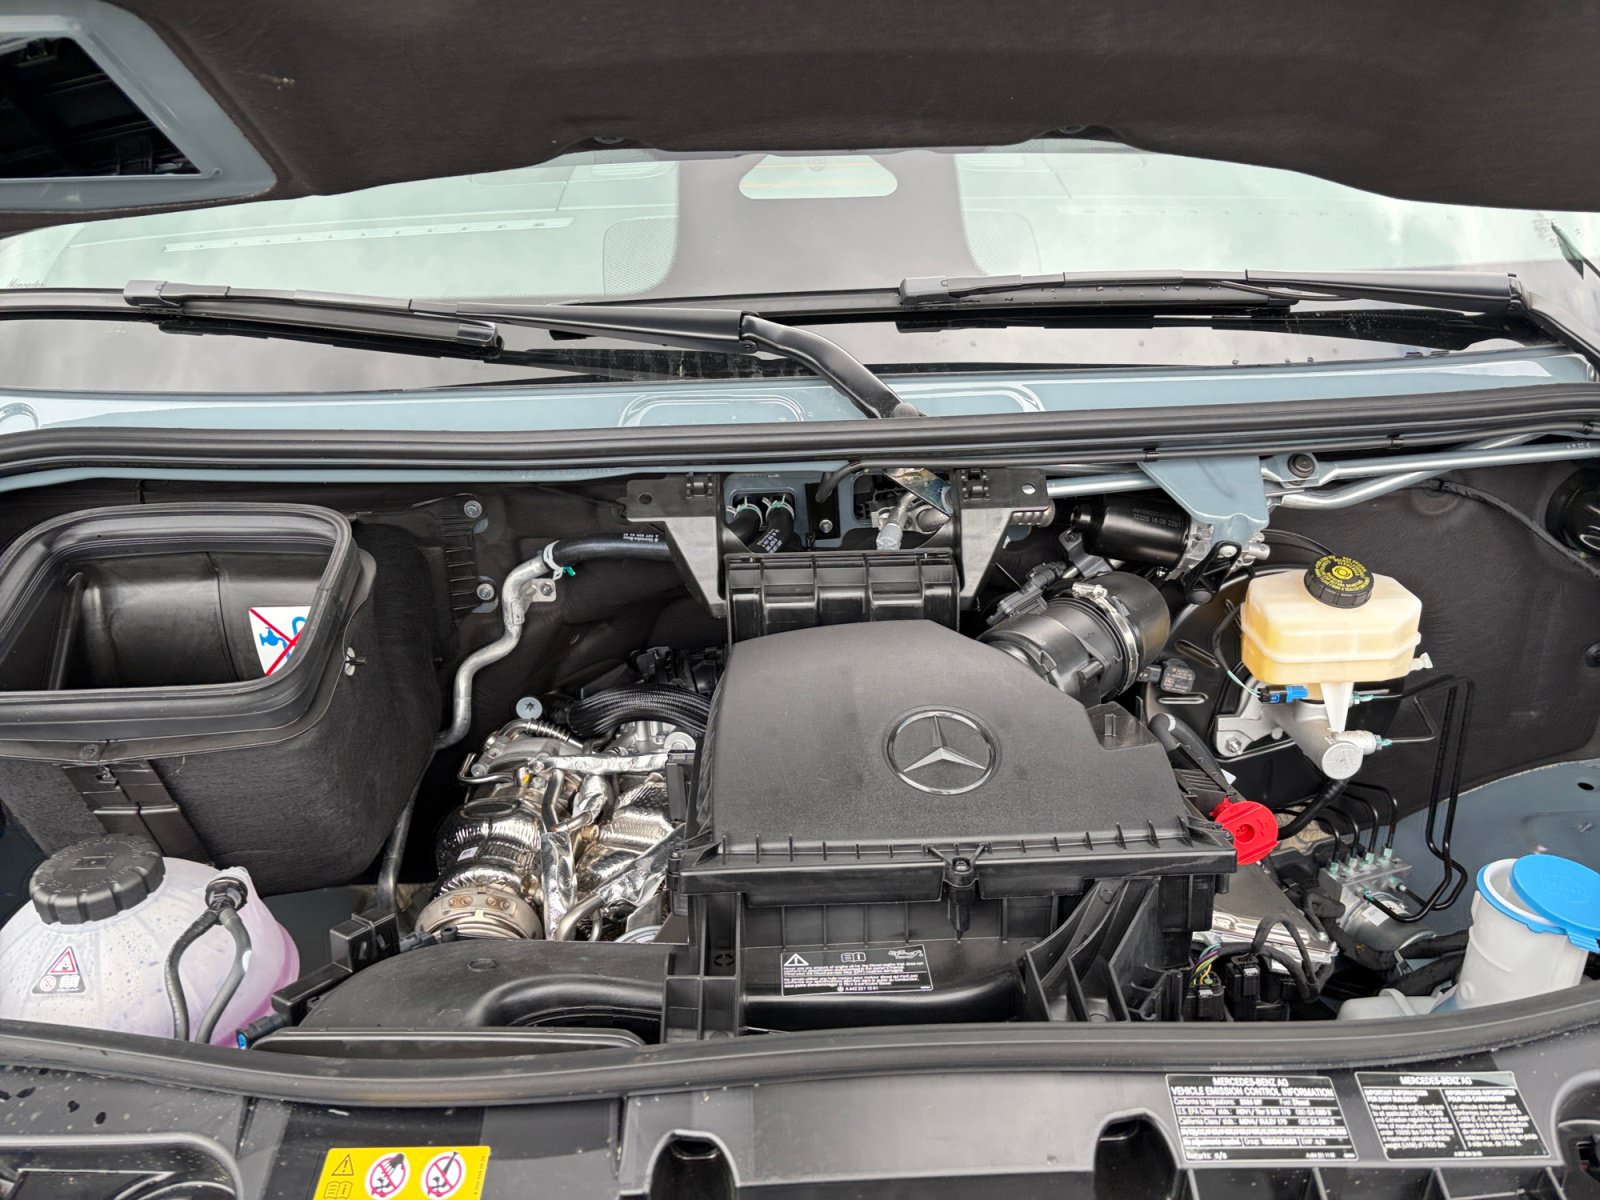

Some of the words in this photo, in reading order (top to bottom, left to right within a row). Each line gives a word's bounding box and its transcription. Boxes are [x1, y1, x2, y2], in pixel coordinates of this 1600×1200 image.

[1212, 1077, 1276, 1087] MERCEDES-BENZ
[1277, 1078, 1289, 1087] AG
[1400, 1076, 1461, 1085] MERCEDES-BENZ
[1461, 1076, 1472, 1085] AG
[1171, 1086, 1204, 1096] VEHICLE
[1205, 1086, 1243, 1096] EMISSION
[1244, 1087, 1281, 1096] CONTROL
[1281, 1088, 1334, 1097] INFORMATION
